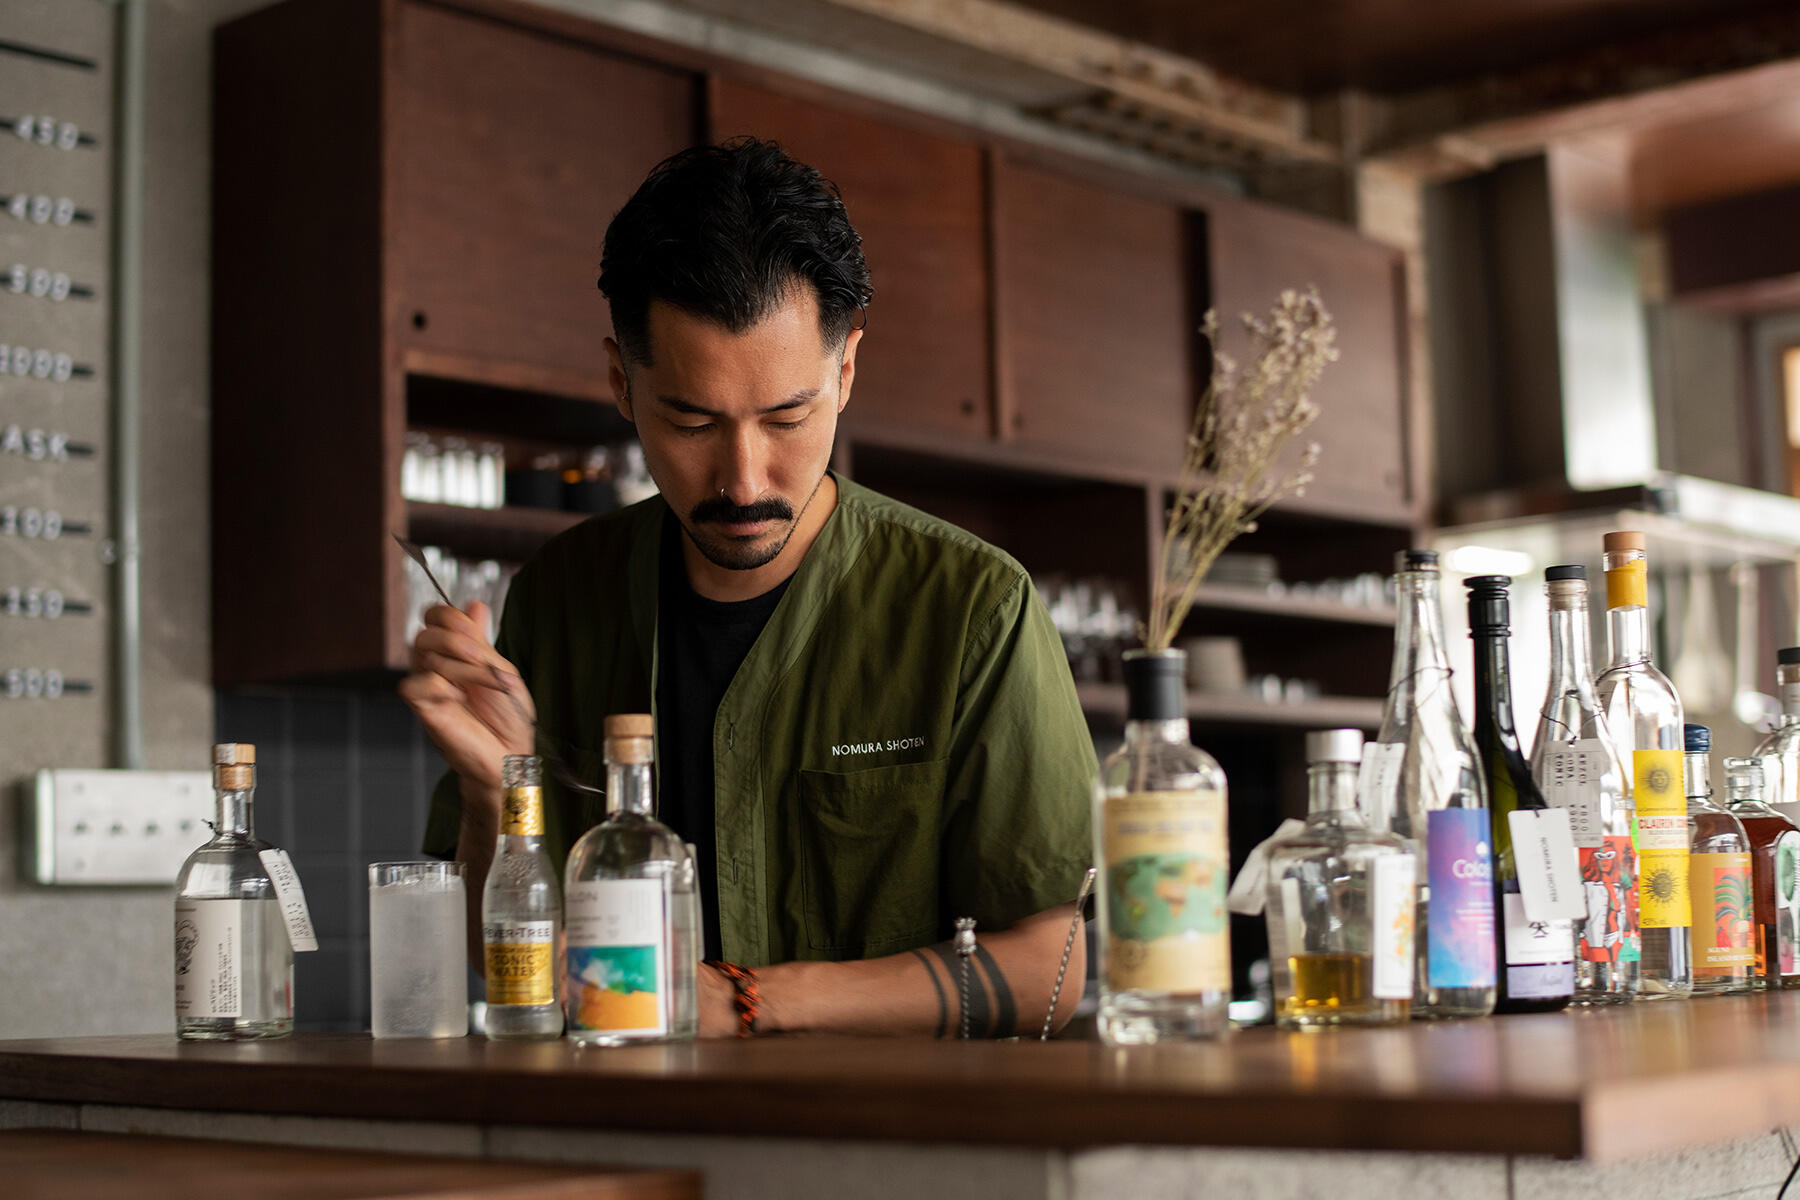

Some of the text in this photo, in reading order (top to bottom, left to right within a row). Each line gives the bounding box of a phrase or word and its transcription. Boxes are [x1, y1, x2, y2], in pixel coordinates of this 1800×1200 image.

[4, 424, 69, 461] ASK
[831, 736, 925, 756] NOMURA SHOTEN
[1554, 754, 1564, 787] TONIC
[494, 954, 536, 966] TONIC
